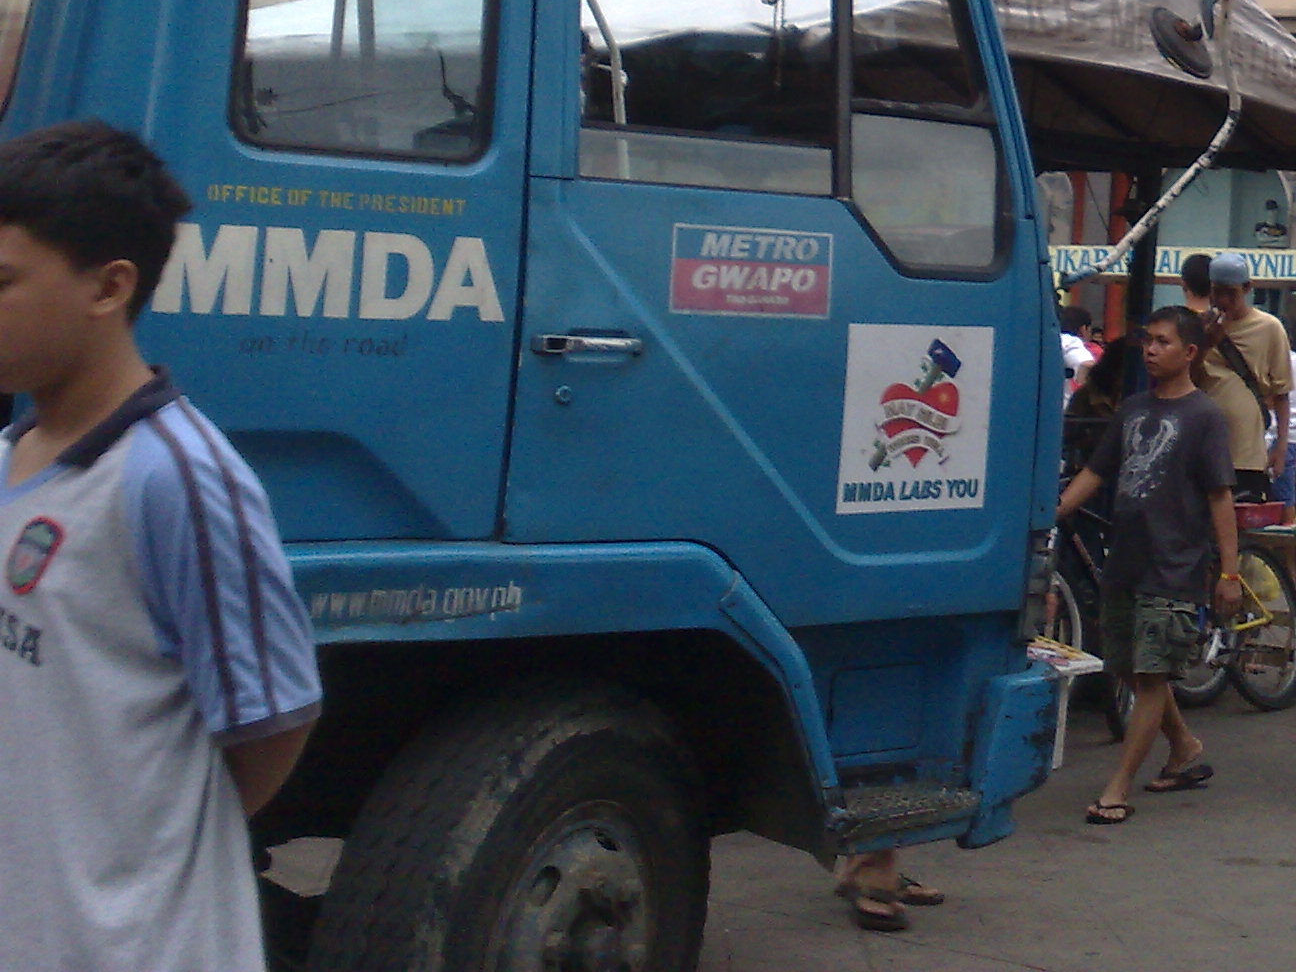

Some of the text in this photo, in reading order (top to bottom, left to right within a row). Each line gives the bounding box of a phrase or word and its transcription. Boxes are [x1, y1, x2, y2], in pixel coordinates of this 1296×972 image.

[207, 184, 468, 217] OFFICE OF THE PRESIDENT
[701, 231, 820, 262] METRO
[151, 222, 506, 323] MMDA
[691, 263, 817, 294] GWAPO
[843, 478, 979, 503] MMDA LABS YOU
